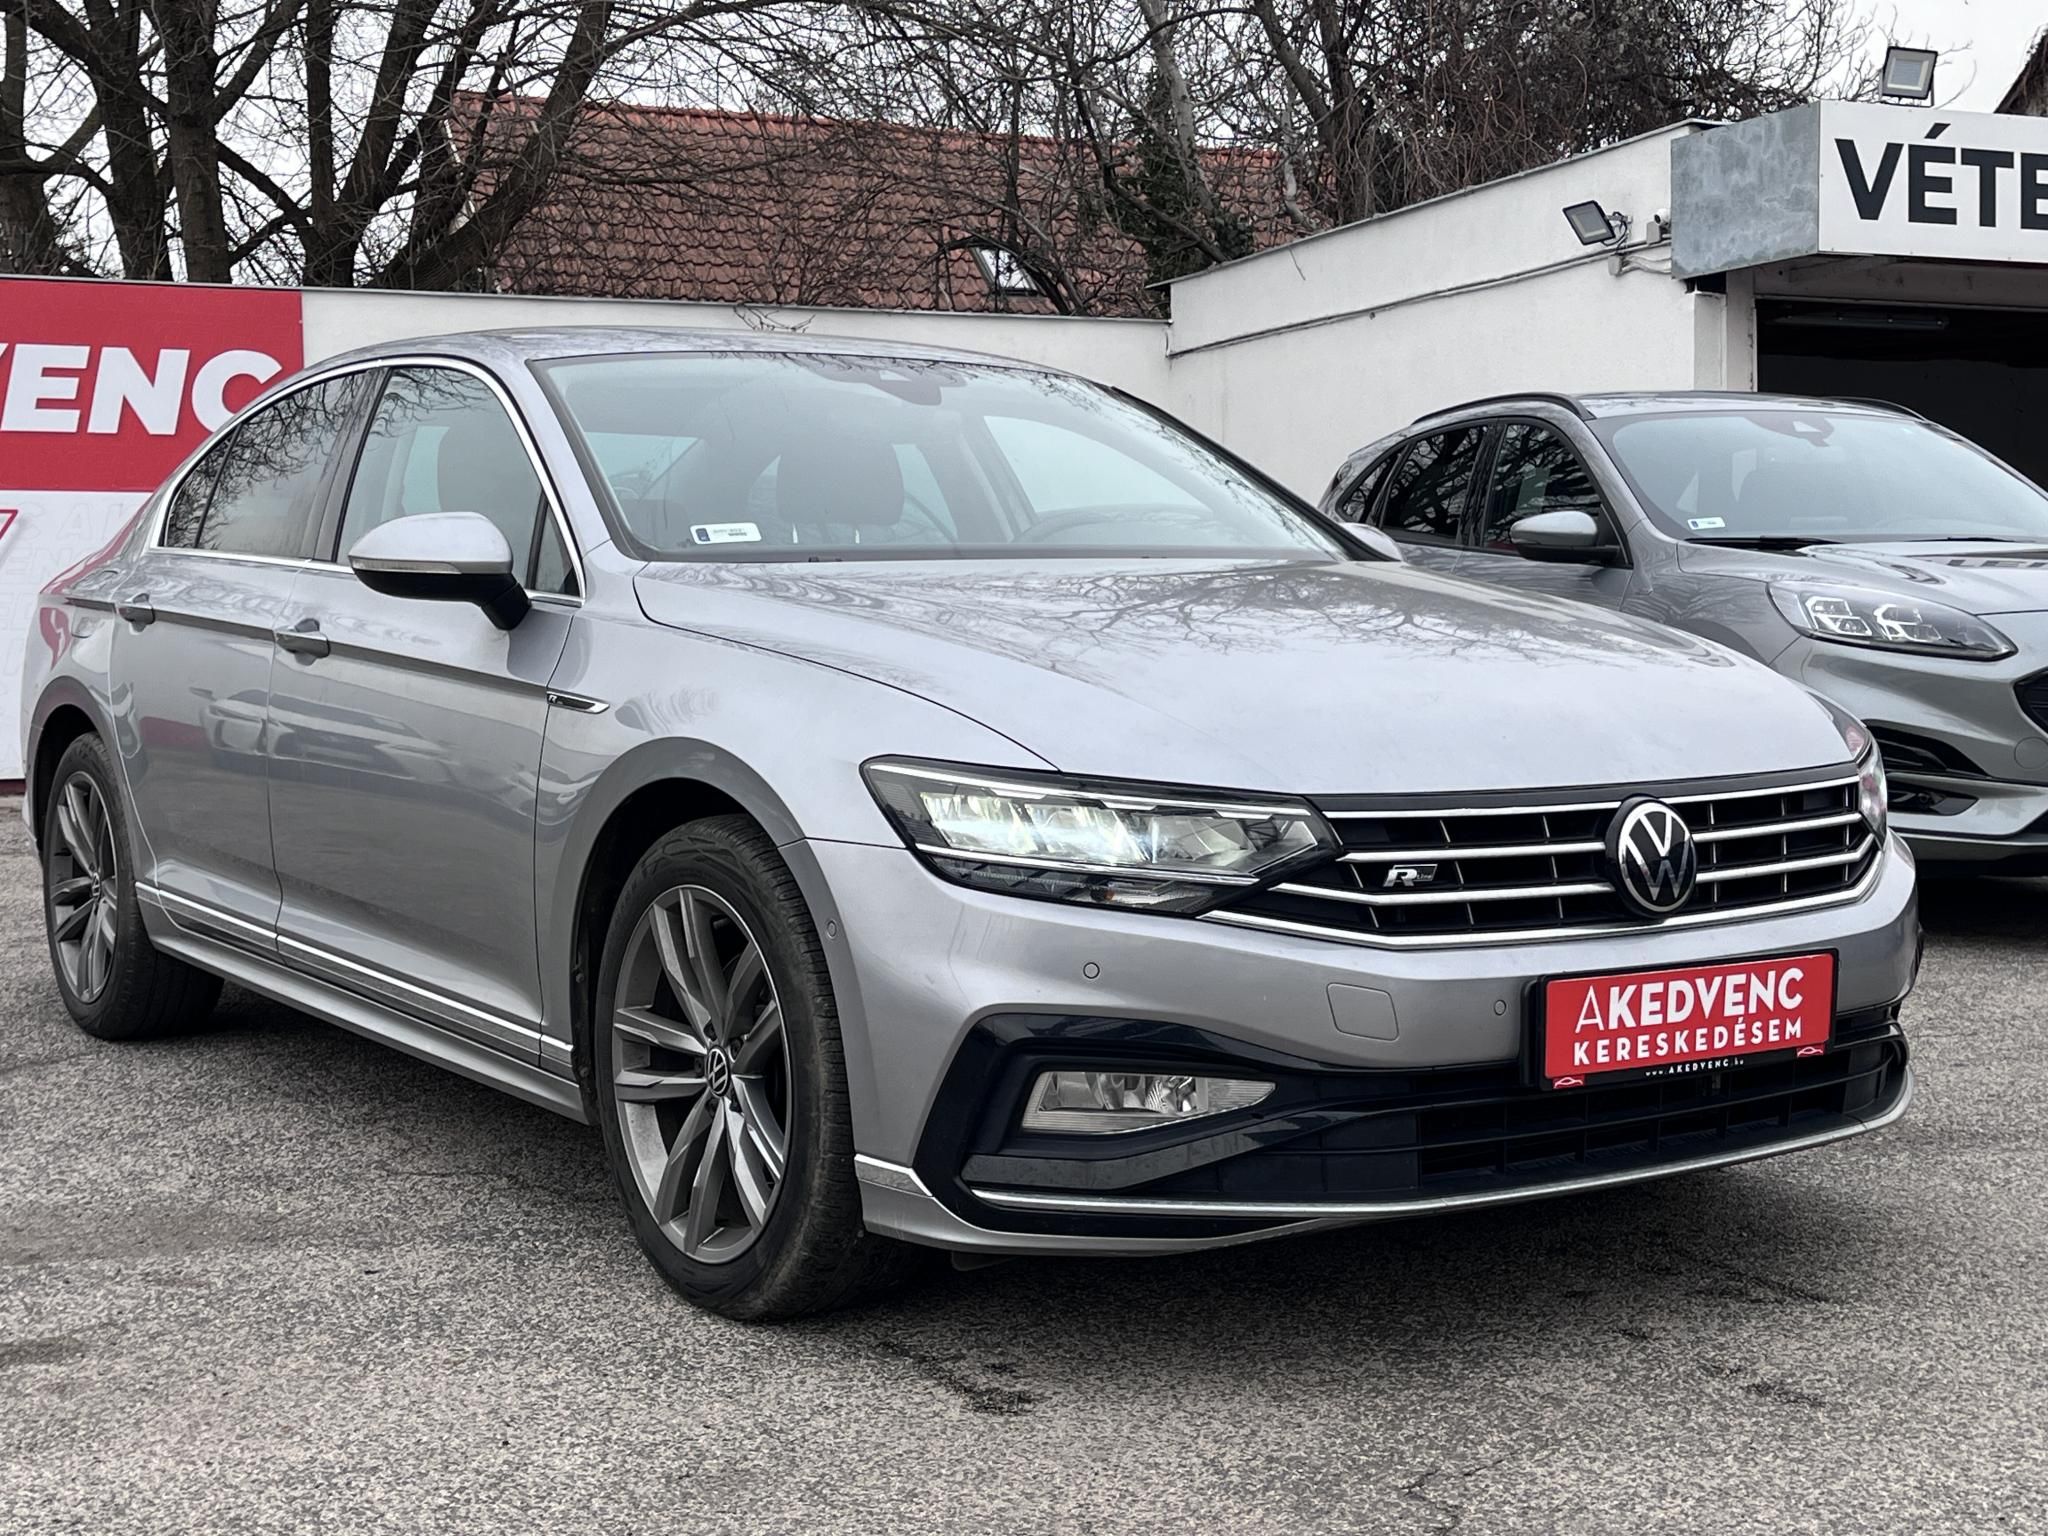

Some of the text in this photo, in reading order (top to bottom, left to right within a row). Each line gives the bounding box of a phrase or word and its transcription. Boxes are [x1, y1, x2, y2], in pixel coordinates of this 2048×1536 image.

[0, 342, 283, 436] ENC
[1575, 967, 1804, 1034] AKEDVENC
[1573, 1016, 1802, 1067] KERESKEDÉSEM
